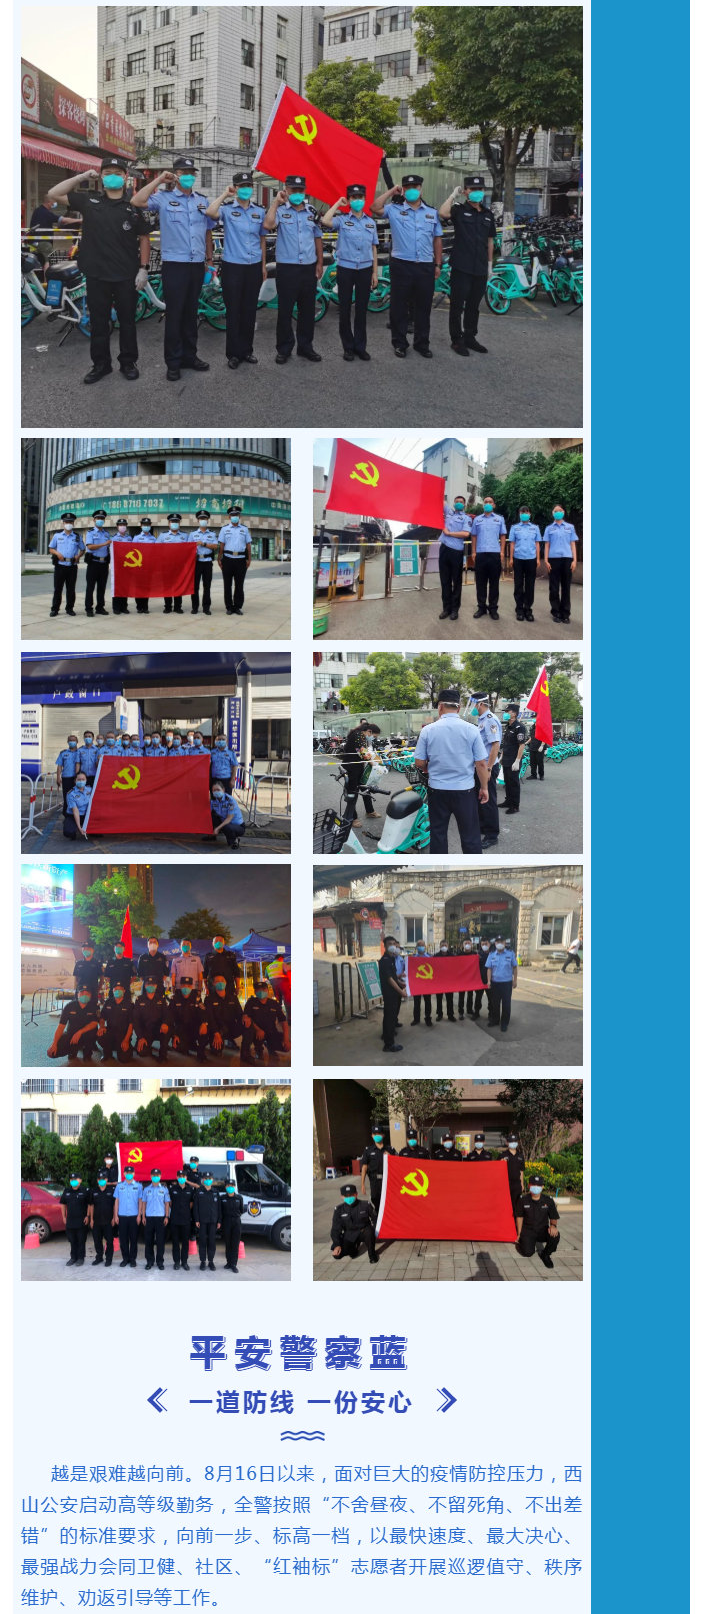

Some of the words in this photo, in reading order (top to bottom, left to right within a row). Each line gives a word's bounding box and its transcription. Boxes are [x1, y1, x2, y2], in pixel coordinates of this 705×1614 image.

[190, 1335, 408, 1371] 平安警察蓝
[189, 1390, 294, 1414] 一道防线
[307, 1390, 412, 1414] 一份安心
[21, 1588, 217, 1606] 维护、劝返引导等工作。
